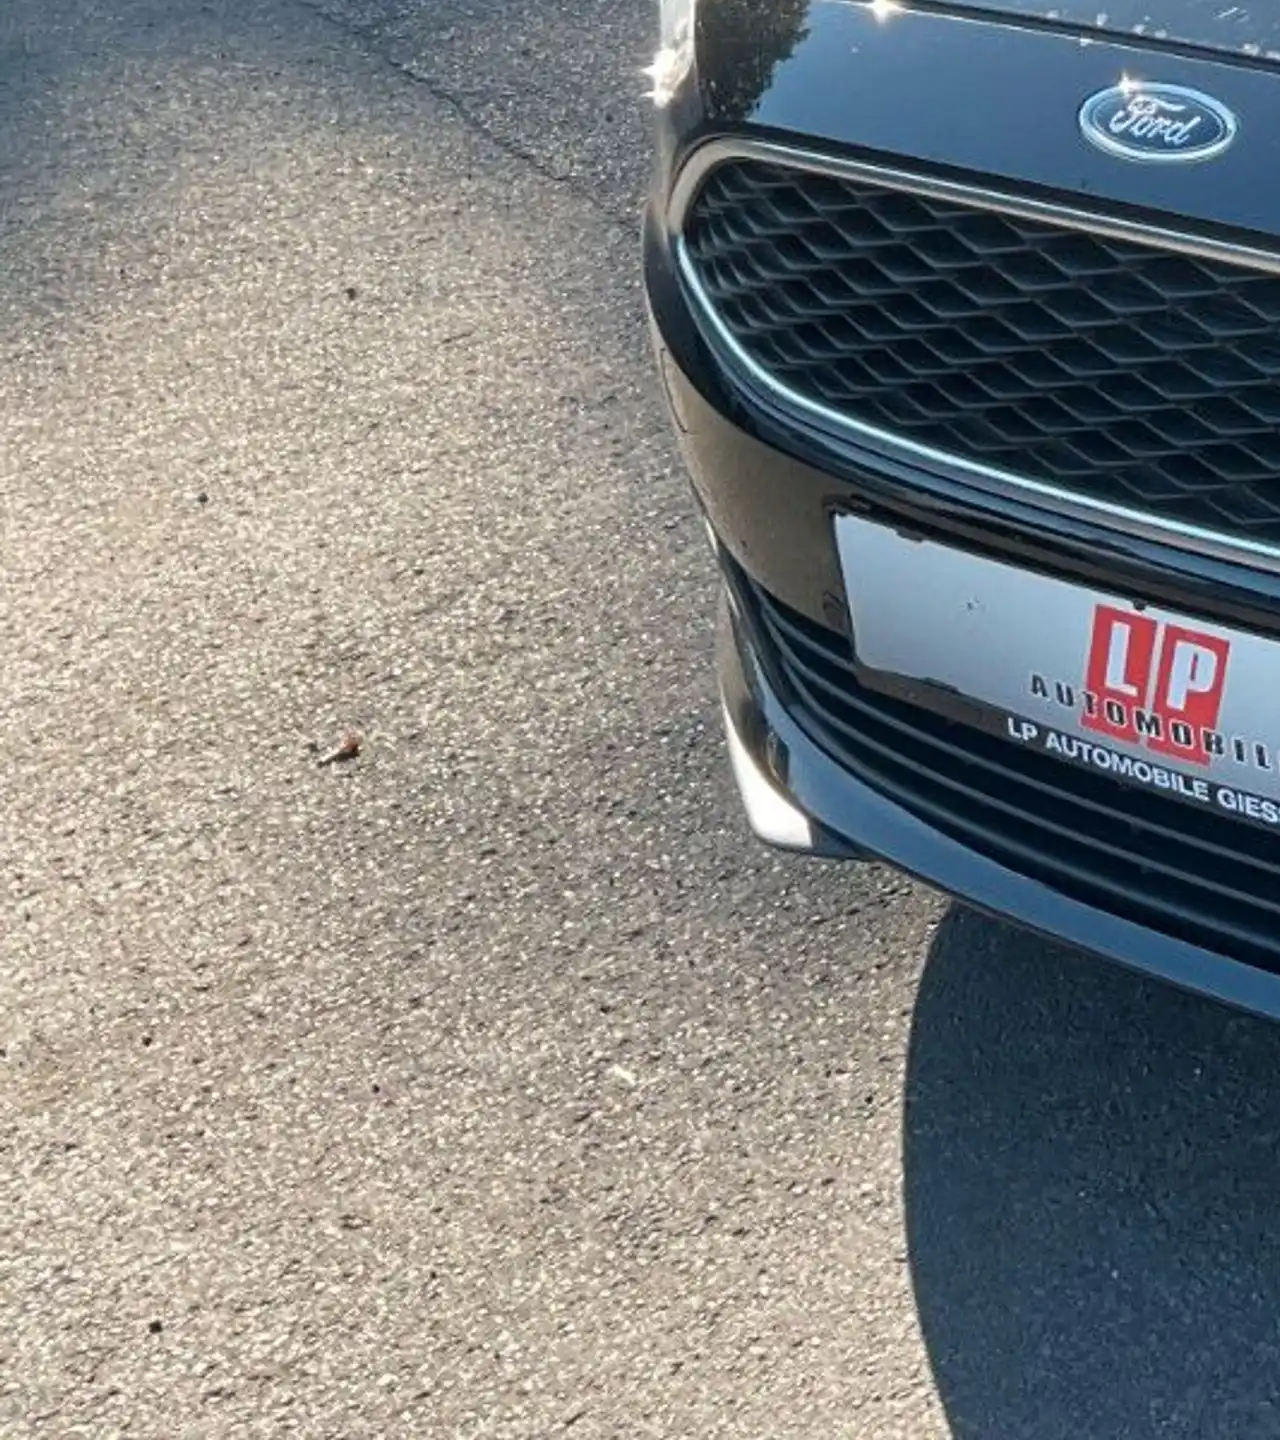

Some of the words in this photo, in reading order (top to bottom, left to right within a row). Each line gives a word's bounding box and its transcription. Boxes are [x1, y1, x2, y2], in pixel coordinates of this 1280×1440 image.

[1108, 96, 1202, 145] Ford
[1104, 620, 1219, 711] LP
[1006, 716, 1039, 742] LP
[1045, 732, 1212, 803] AUTOMOBILE
